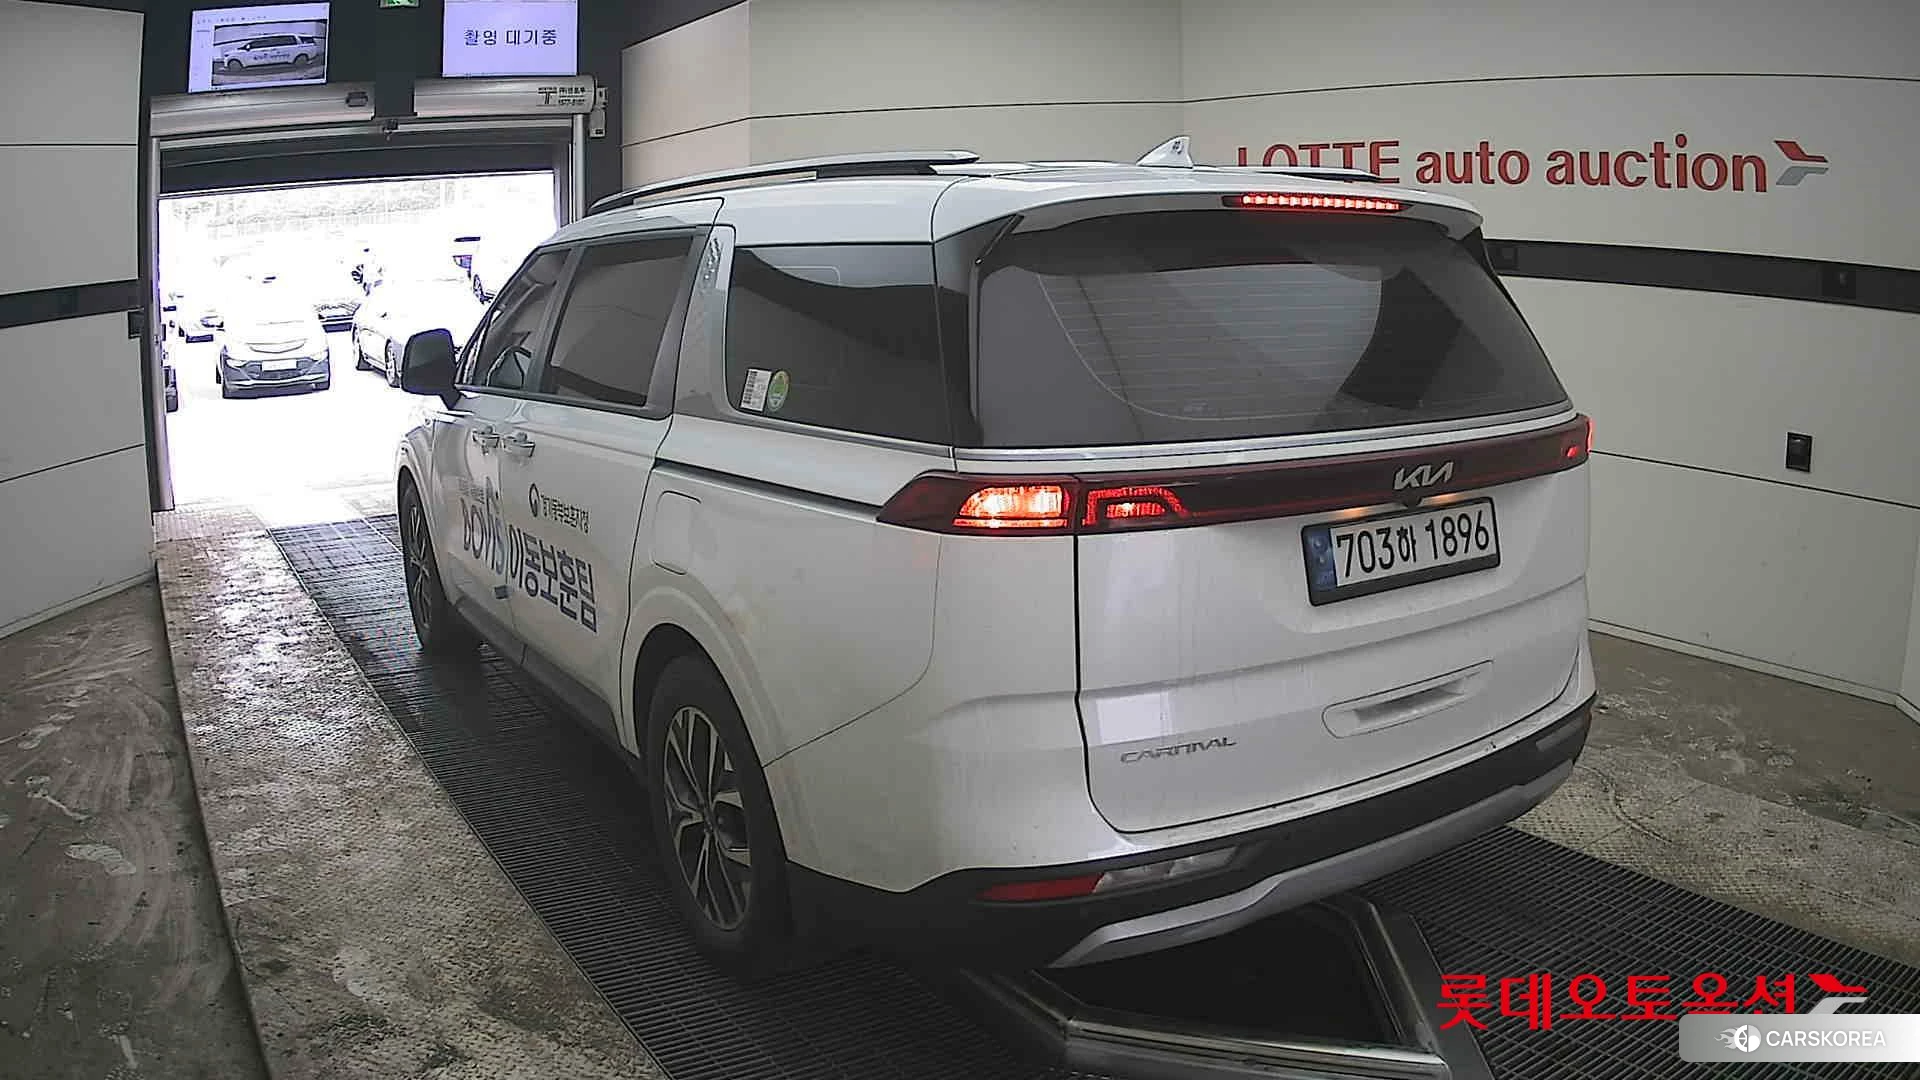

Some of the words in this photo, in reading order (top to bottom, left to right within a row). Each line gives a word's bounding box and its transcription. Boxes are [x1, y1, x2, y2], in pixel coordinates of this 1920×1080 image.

[463, 29, 497, 46] 촬영
[505, 29, 557, 46] 대기중
[1415, 140, 1530, 186] auto
[1547, 135, 1767, 192] auction
[1336, 525, 1417, 578] 703하
[1425, 510, 1490, 560] 1896
[509, 524, 597, 633] 이동보훈팀
